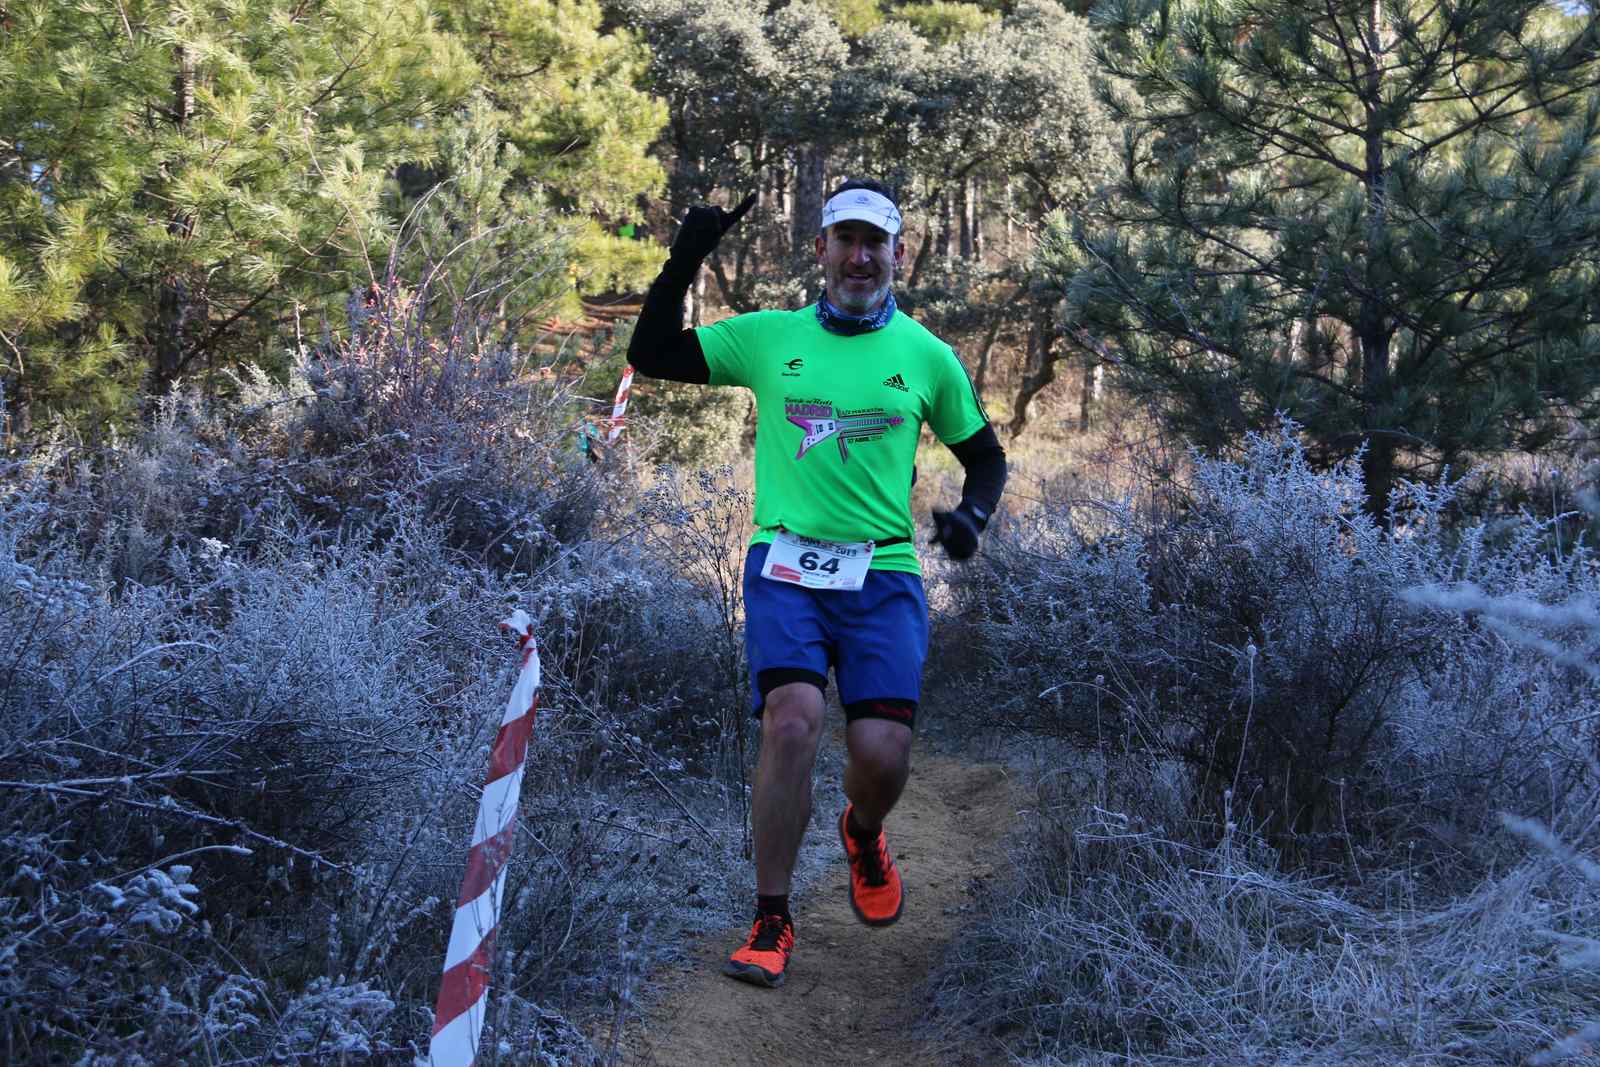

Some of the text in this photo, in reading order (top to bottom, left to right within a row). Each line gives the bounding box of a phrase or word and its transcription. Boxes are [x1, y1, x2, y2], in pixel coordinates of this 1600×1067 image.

[882, 381, 909, 392] adidas
[785, 404, 832, 417] MADRID
[799, 551, 840, 574] 64
